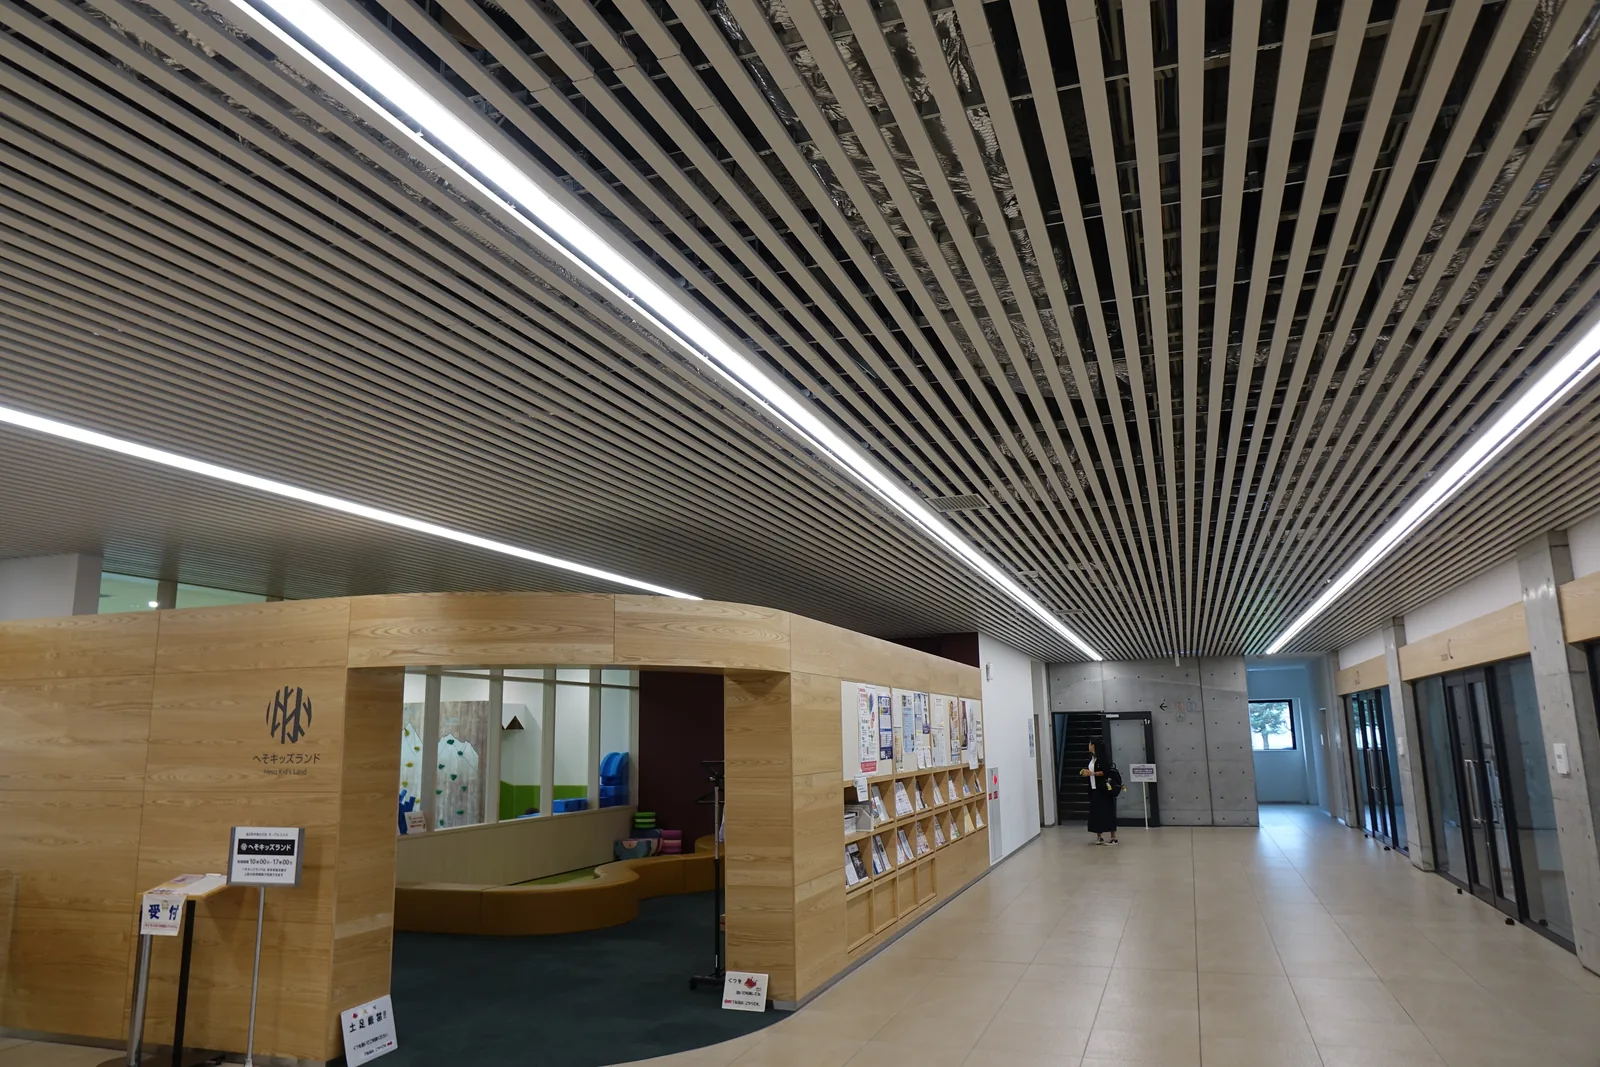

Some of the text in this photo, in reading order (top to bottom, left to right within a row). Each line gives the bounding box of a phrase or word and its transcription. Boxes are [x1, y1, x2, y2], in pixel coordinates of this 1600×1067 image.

[253, 753, 320, 764] へそキッズランド
[248, 843, 292, 852] へそキッズランド
[149, 904, 180, 920] 受付
